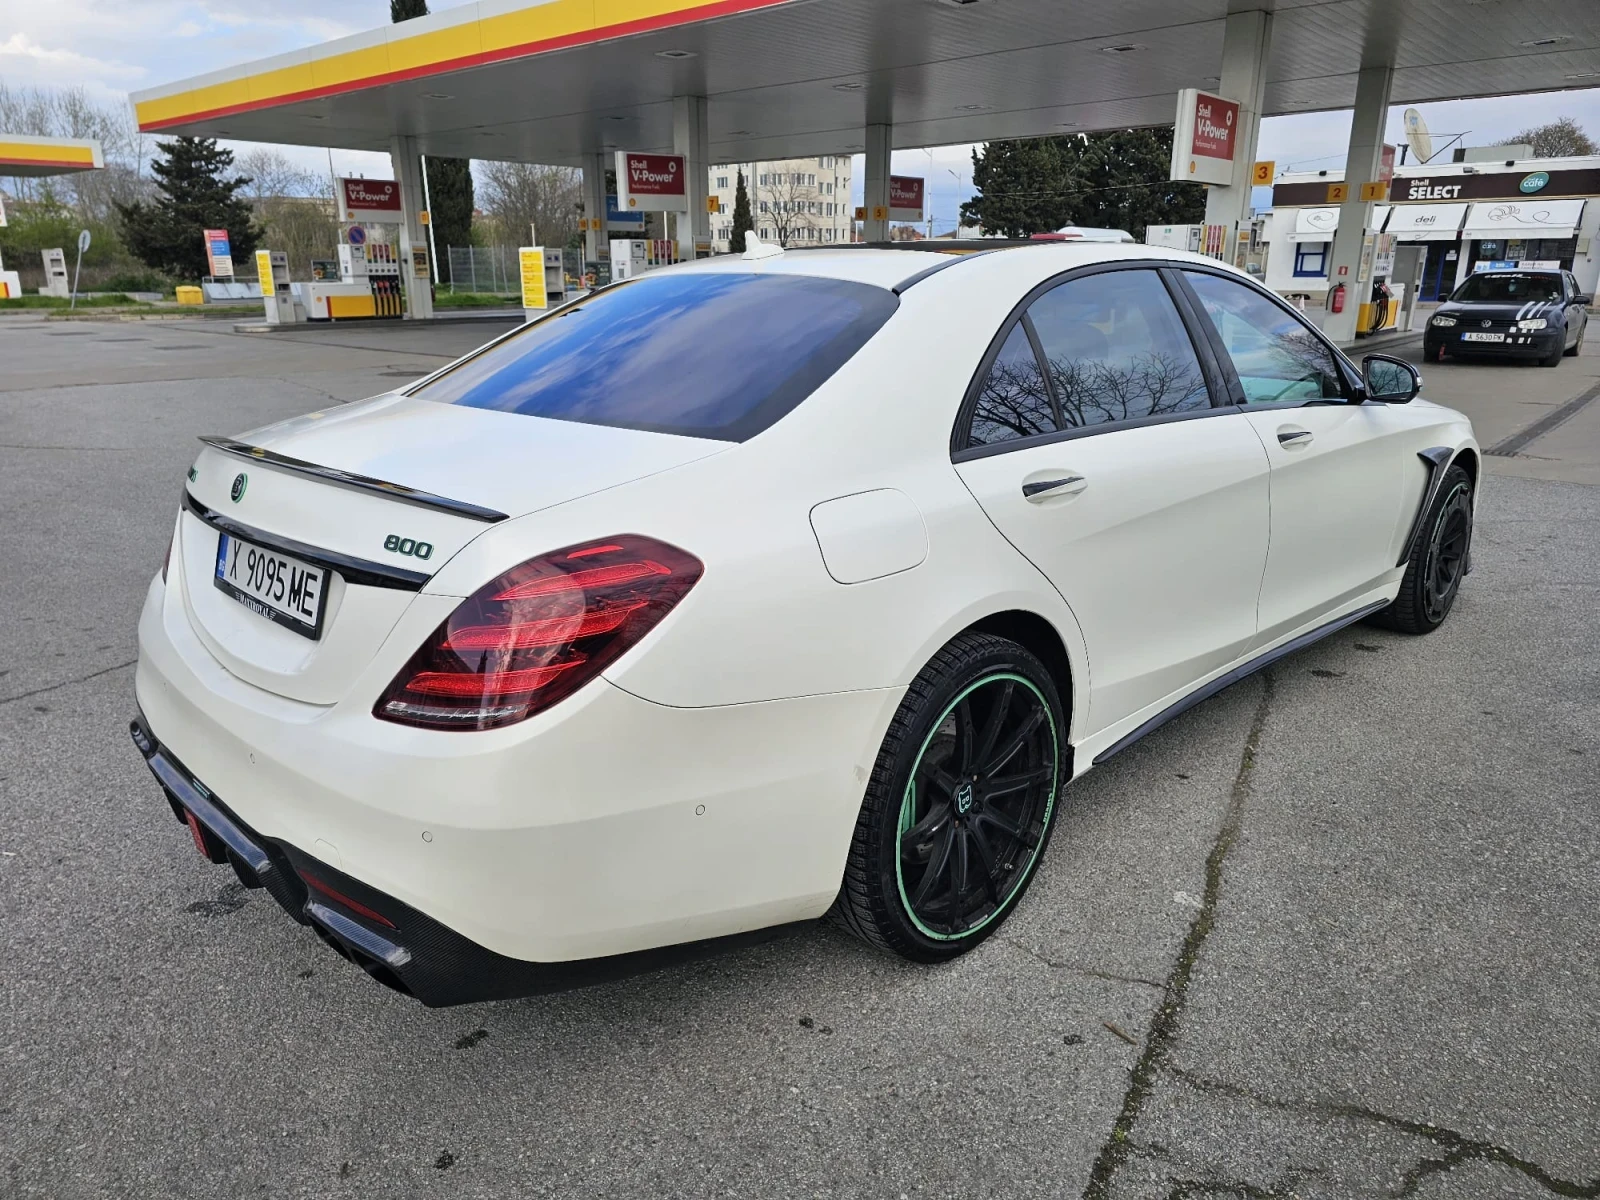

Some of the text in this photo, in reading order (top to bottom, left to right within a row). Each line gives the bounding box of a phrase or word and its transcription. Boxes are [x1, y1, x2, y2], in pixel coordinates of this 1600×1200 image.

[1198, 104, 1212, 118] Shell
[1198, 118, 1228, 140] V-Power
[630, 160, 647, 169] Shell
[631, 170, 674, 182] V-Power
[1258, 166, 1268, 179] 3
[348, 183, 364, 191] Shell
[1410, 179, 1430, 187] Shell
[349, 191, 390, 202] V-Power
[891, 189, 916, 199] V-Power
[1333, 187, 1341, 198] 2
[1369, 186, 1375, 197] 1
[1408, 185, 1462, 200] SELECT
[708, 199, 715, 209] 7
[857, 209, 863, 219] 6
[876, 208, 882, 218] 5
[1415, 215, 1437, 223] deli
[383, 534, 434, 561] 800
[230, 540, 318, 618] X 9095 ME
